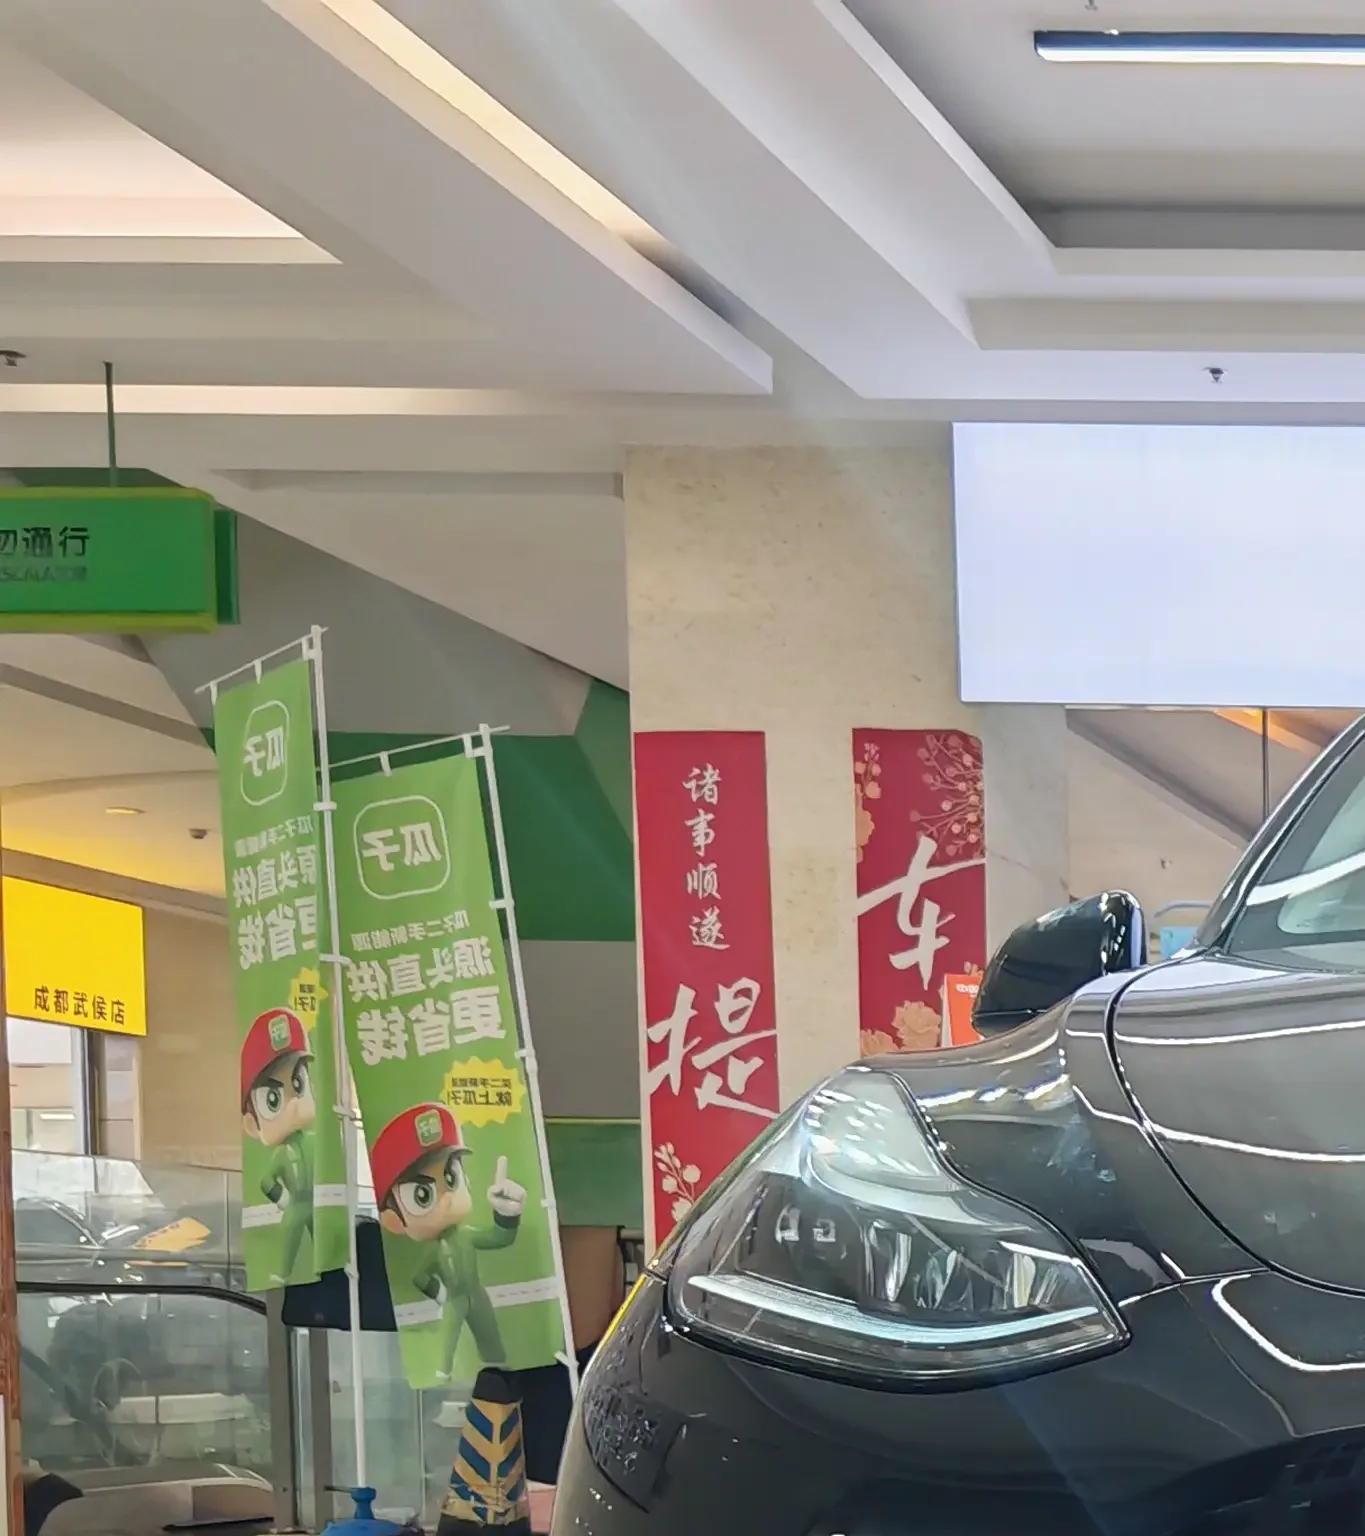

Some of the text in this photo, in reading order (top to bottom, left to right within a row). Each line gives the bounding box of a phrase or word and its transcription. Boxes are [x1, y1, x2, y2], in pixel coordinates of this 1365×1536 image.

[682, 763, 730, 950] 诸事顺遂
[857, 835, 986, 991] 车
[34, 984, 126, 1026] 成都武侯店
[645, 977, 779, 1119] 提
